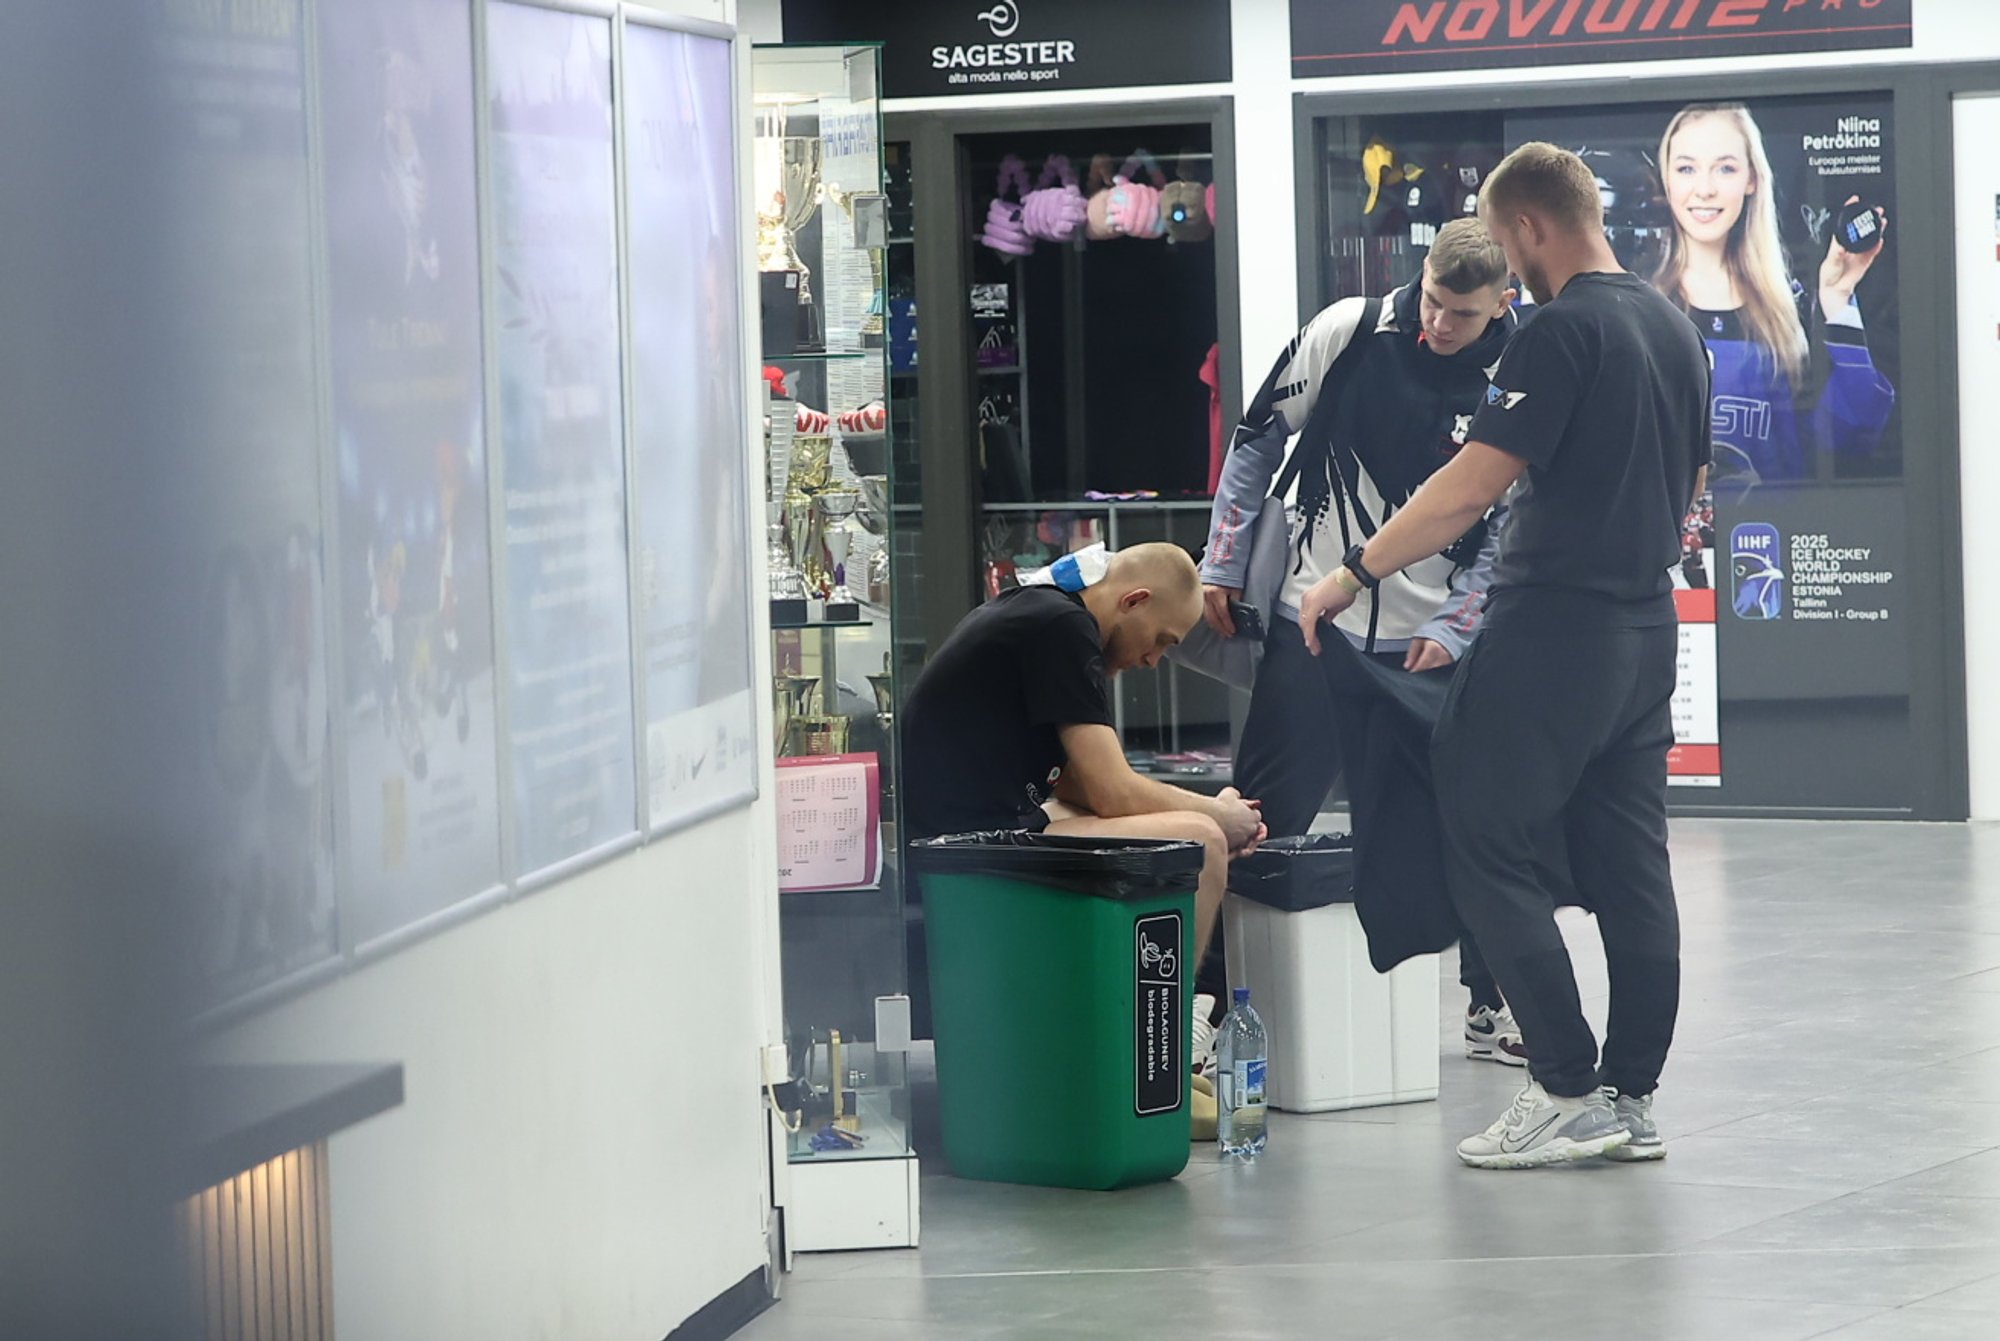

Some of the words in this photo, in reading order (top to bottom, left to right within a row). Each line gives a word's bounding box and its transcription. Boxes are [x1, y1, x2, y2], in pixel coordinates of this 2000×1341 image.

[931, 40, 1075, 69] SAGESTER
[948, 73, 968, 84] alta
[970, 71, 1001, 83] moda
[1003, 70, 1028, 81] nello
[1030, 68, 1059, 82] sport
[1837, 116, 1880, 132] Niina
[1737, 534, 1771, 549] IIHF
[1791, 534, 1829, 549] 2025
[1791, 549, 1814, 561] ICE
[1816, 548, 1871, 561] HOCKEY
[1791, 560, 1841, 572] WORLD
[1791, 572, 1893, 584] CHAMPIONSHIP
[1792, 585, 1842, 596] ESTONIA
[1792, 597, 1827, 608] Tallinn
[1793, 609, 1832, 619] Division
[1846, 609, 1878, 621] Group
[1880, 609, 1888, 619] B
[1146, 989, 1156, 1082] biodegradable
[1161, 987, 1169, 1072] BIOLAGUNEV
